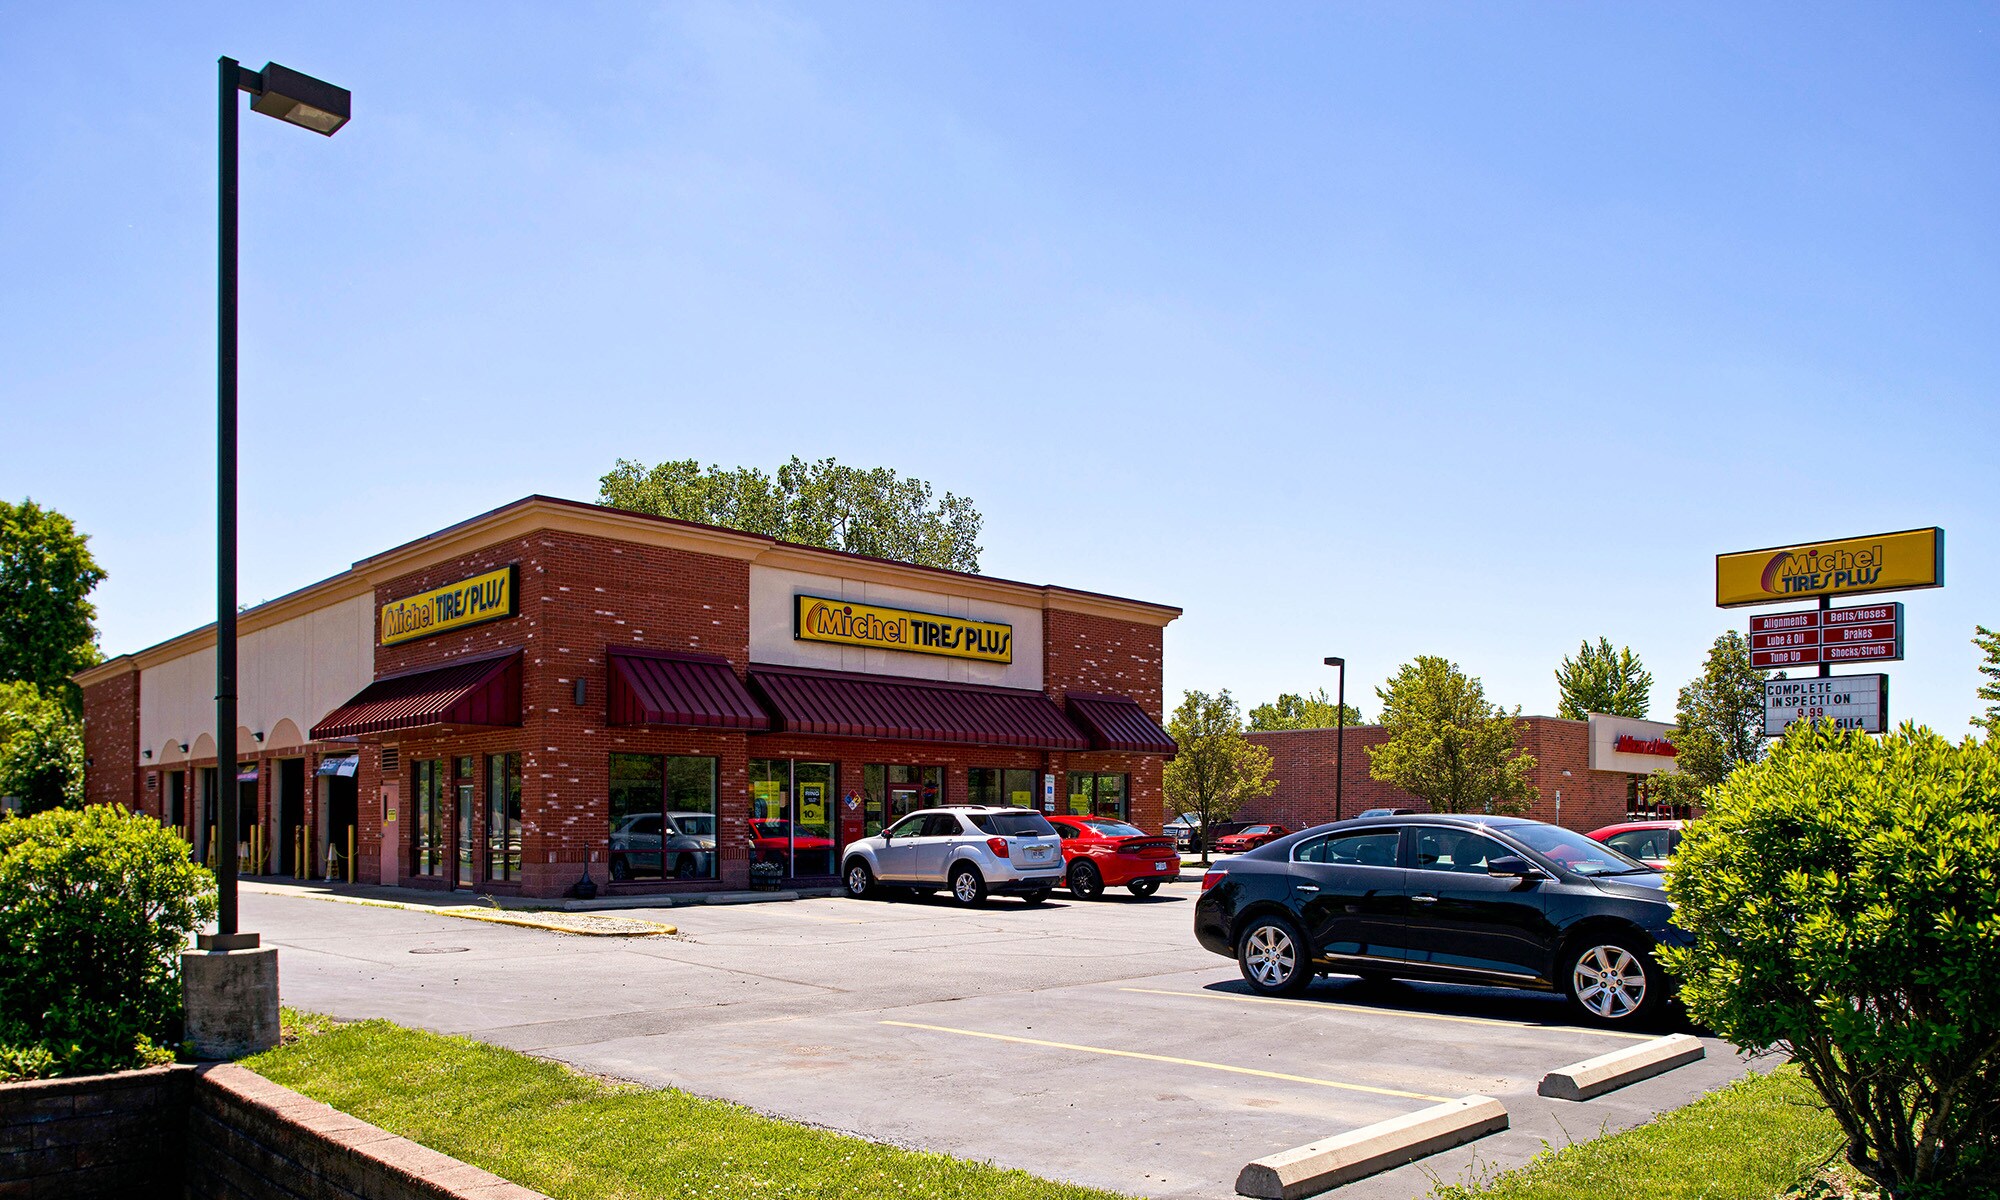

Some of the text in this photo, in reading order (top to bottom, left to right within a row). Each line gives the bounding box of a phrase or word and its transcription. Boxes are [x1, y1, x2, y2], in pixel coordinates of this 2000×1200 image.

[1782, 545, 1882, 577] Michel
[1782, 566, 1882, 594] TIRES PLUS
[386, 576, 505, 637] Michel TIRES PLUS
[1830, 609, 1887, 622] Belts/Hoses
[1763, 616, 1808, 629] Alignments
[817, 606, 1010, 656] Michel TIRES PLUS
[1843, 629, 1873, 640] Brakes
[1767, 633, 1804, 646] Lube & Oil
[1770, 651, 1801, 663] Tune Up
[1831, 645, 1886, 658] Shocks/Struts
[1767, 682, 1832, 696] COMPLETE
[1772, 694, 1851, 708] INSPECTION
[1797, 707, 1824, 718] 9.99
